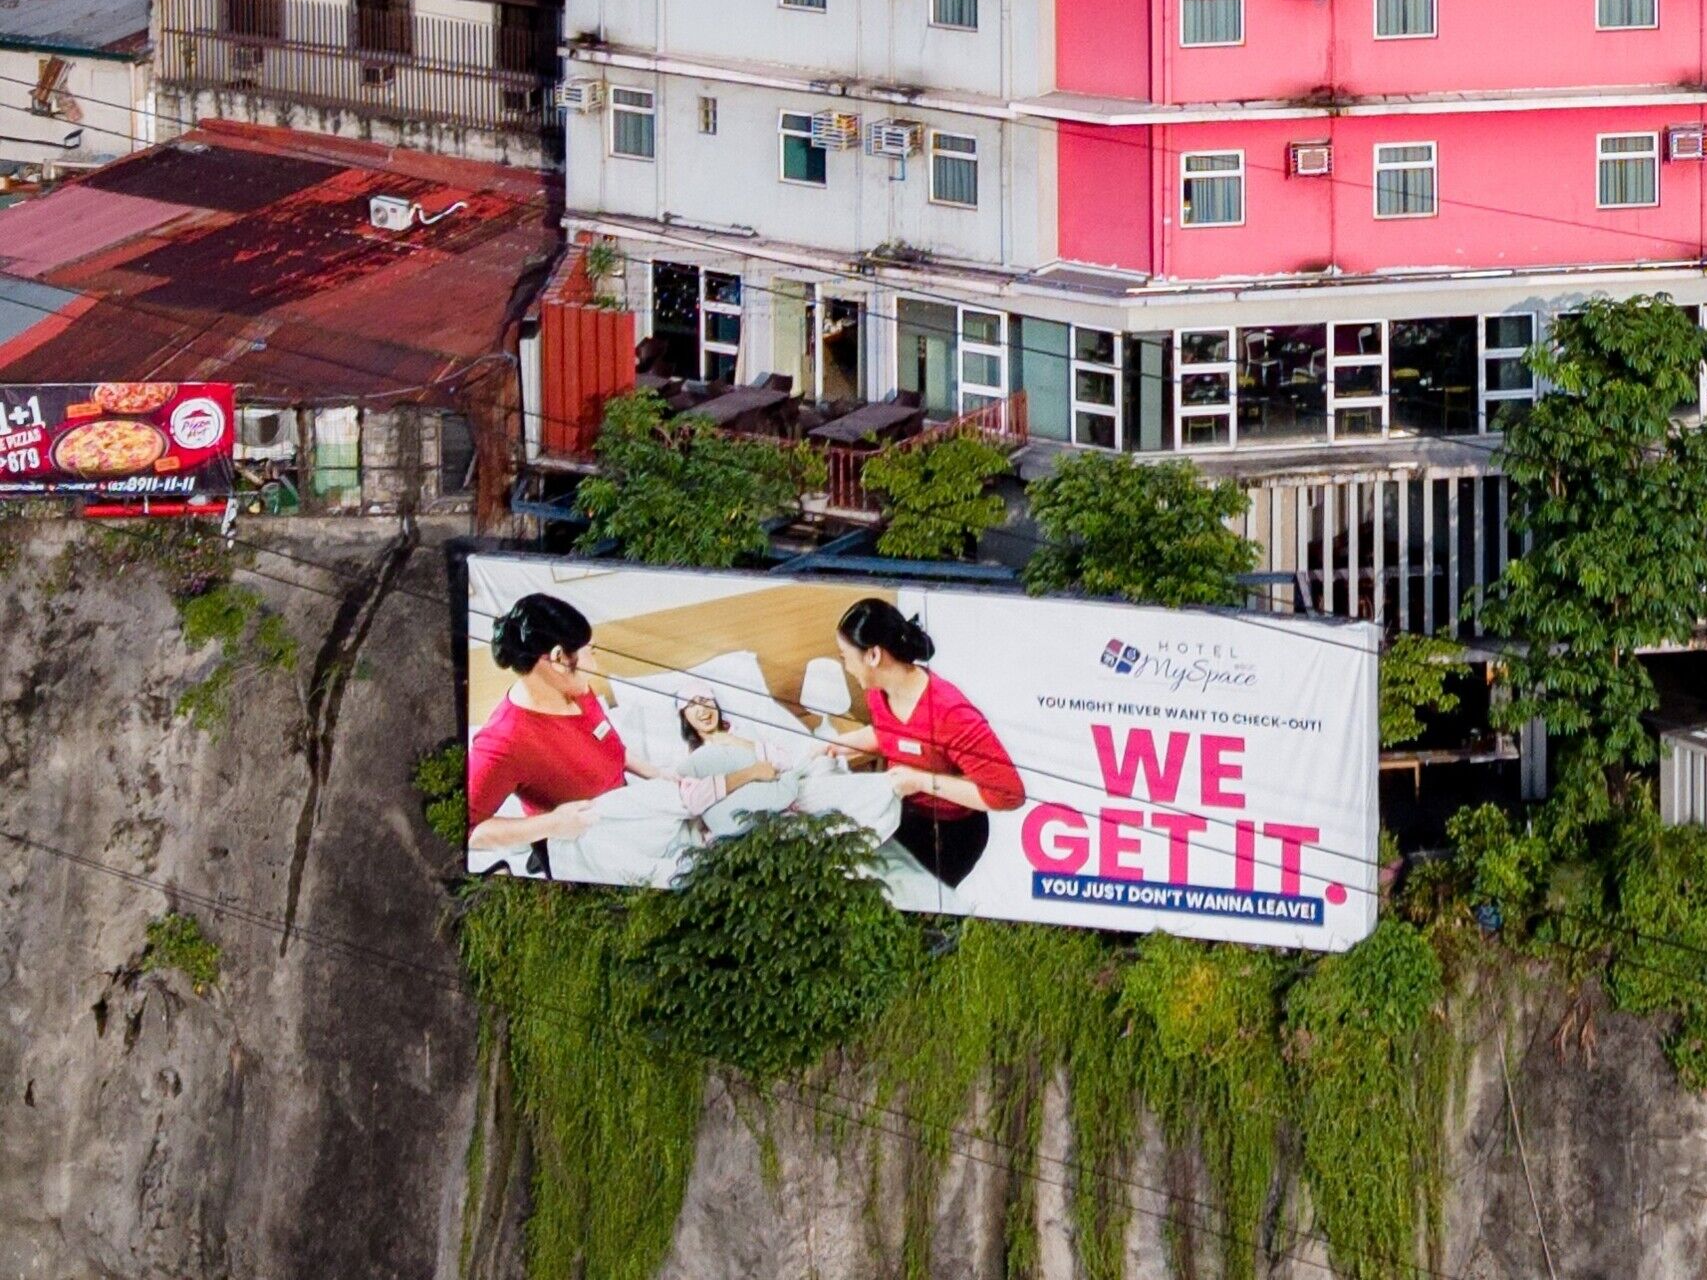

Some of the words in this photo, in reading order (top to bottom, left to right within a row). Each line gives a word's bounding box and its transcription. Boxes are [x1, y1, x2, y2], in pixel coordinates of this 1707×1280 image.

[1158, 640, 1239, 659] HOTEL
[1135, 653, 1258, 693] MySpace
[1037, 696, 1066, 709] YOU
[1069, 698, 1114, 713] MIGHT
[1117, 702, 1161, 717] NEVER
[1165, 706, 1206, 721] WANT
[1210, 710, 1229, 723] TO
[1232, 712, 1322, 733] CHECK-OUT!
[1091, 724, 1245, 809] WE
[1021, 802, 1207, 885] GET
[1233, 819, 1348, 905] IT.
[1041, 877, 1079, 896] YOU
[1081, 882, 1125, 901] JUST
[1127, 884, 1183, 907] DON'T
[1186, 891, 1254, 915] WANNA
[1257, 898, 1316, 920] LEAVE!
